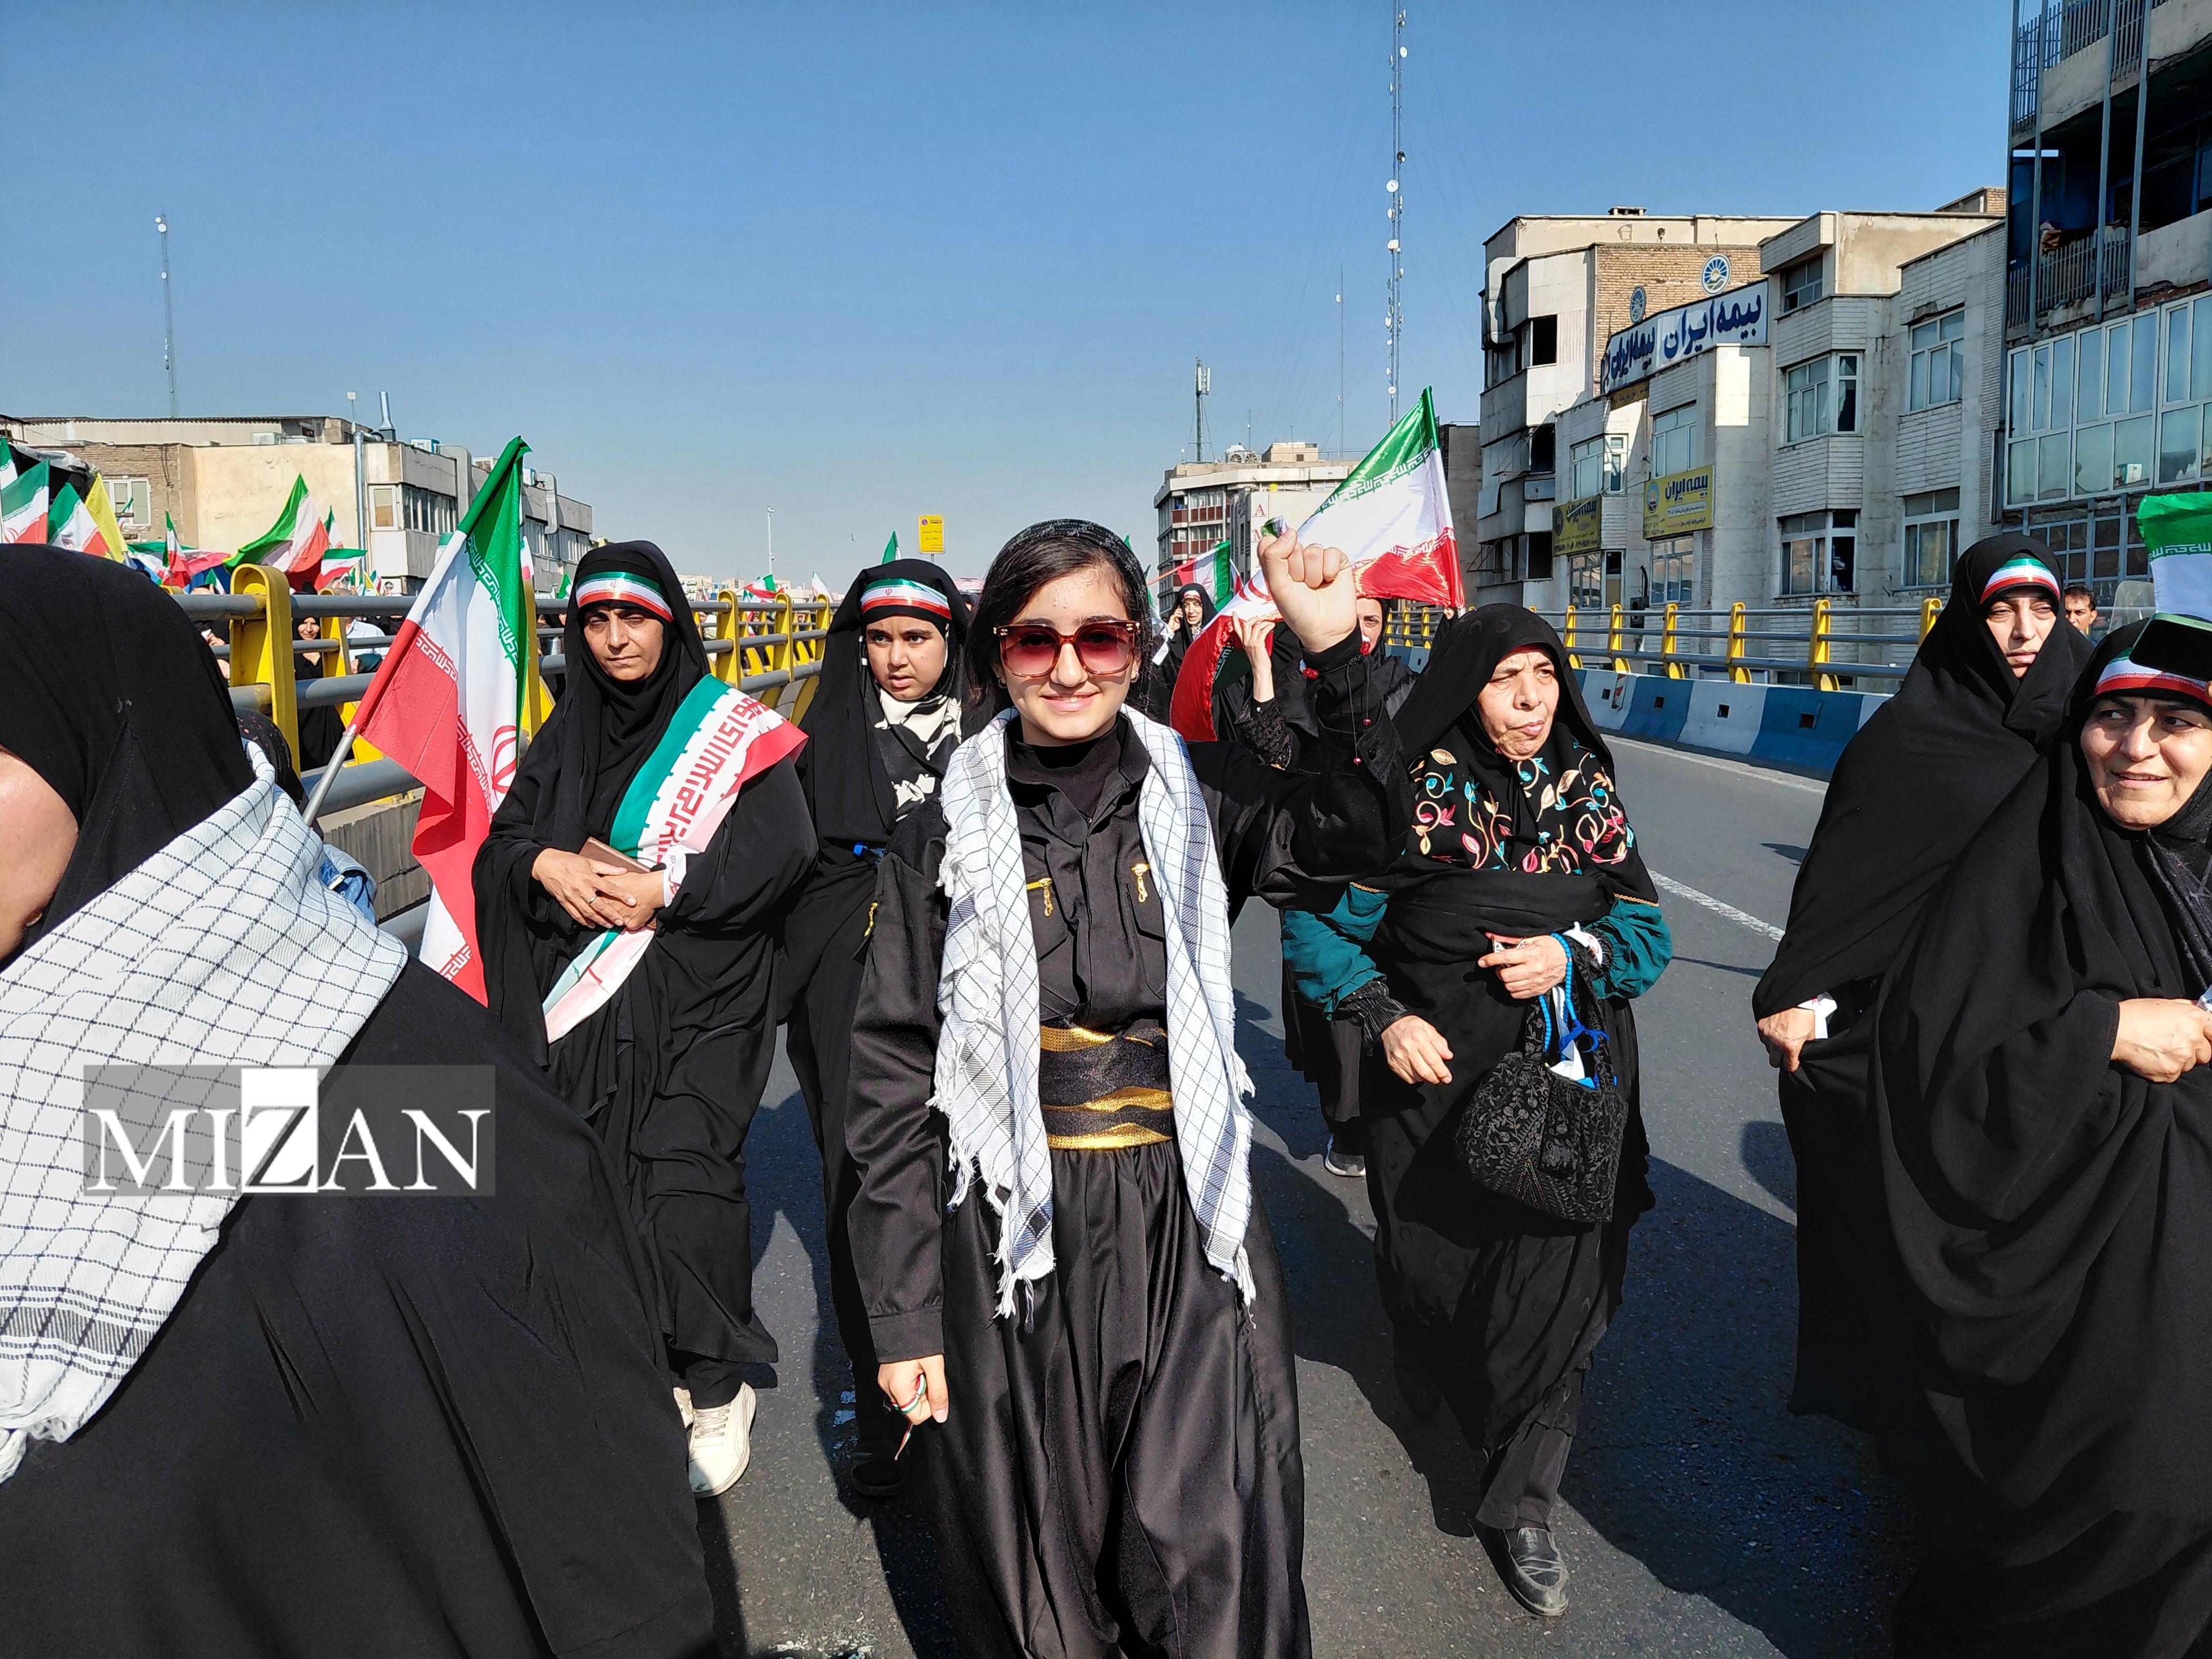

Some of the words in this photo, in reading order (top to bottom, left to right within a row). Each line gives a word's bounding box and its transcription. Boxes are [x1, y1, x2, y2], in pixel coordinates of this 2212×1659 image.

[1663, 300, 1715, 359] ایران
[1716, 294, 1761, 340] بیمه
[1611, 333, 1634, 380] ایران
[1632, 326, 1655, 370] بیمه
[1665, 478, 1686, 502] ایران
[1687, 475, 1708, 497] بیمه
